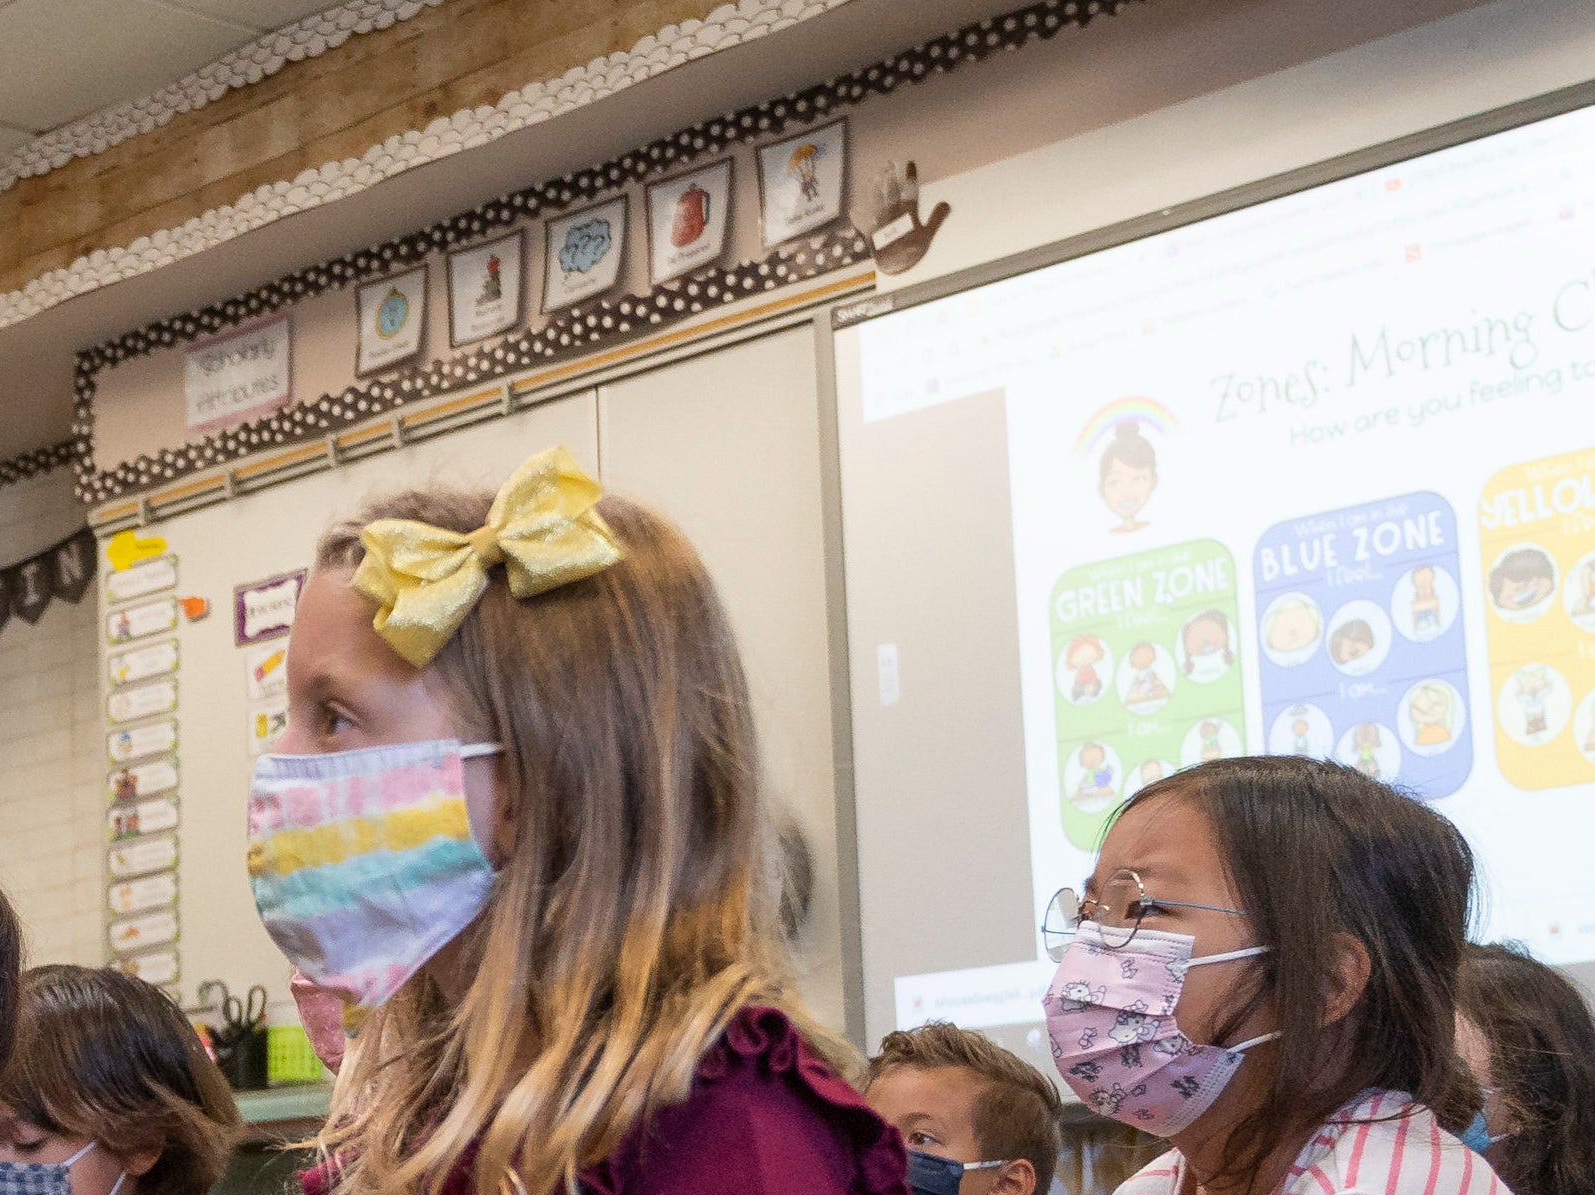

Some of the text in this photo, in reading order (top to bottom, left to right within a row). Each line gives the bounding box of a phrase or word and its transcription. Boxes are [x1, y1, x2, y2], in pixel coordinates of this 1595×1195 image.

[1346, 308, 1538, 388] Morning
[1552, 269, 1595, 333] C
[1290, 417, 1346, 448] How
[1353, 404, 1401, 433] are
[1407, 391, 1463, 428] you
[1468, 366, 1564, 404] feeling
[1260, 510, 1445, 582] BLUE ZONE
[1058, 558, 1229, 622] GREEN ZONE
